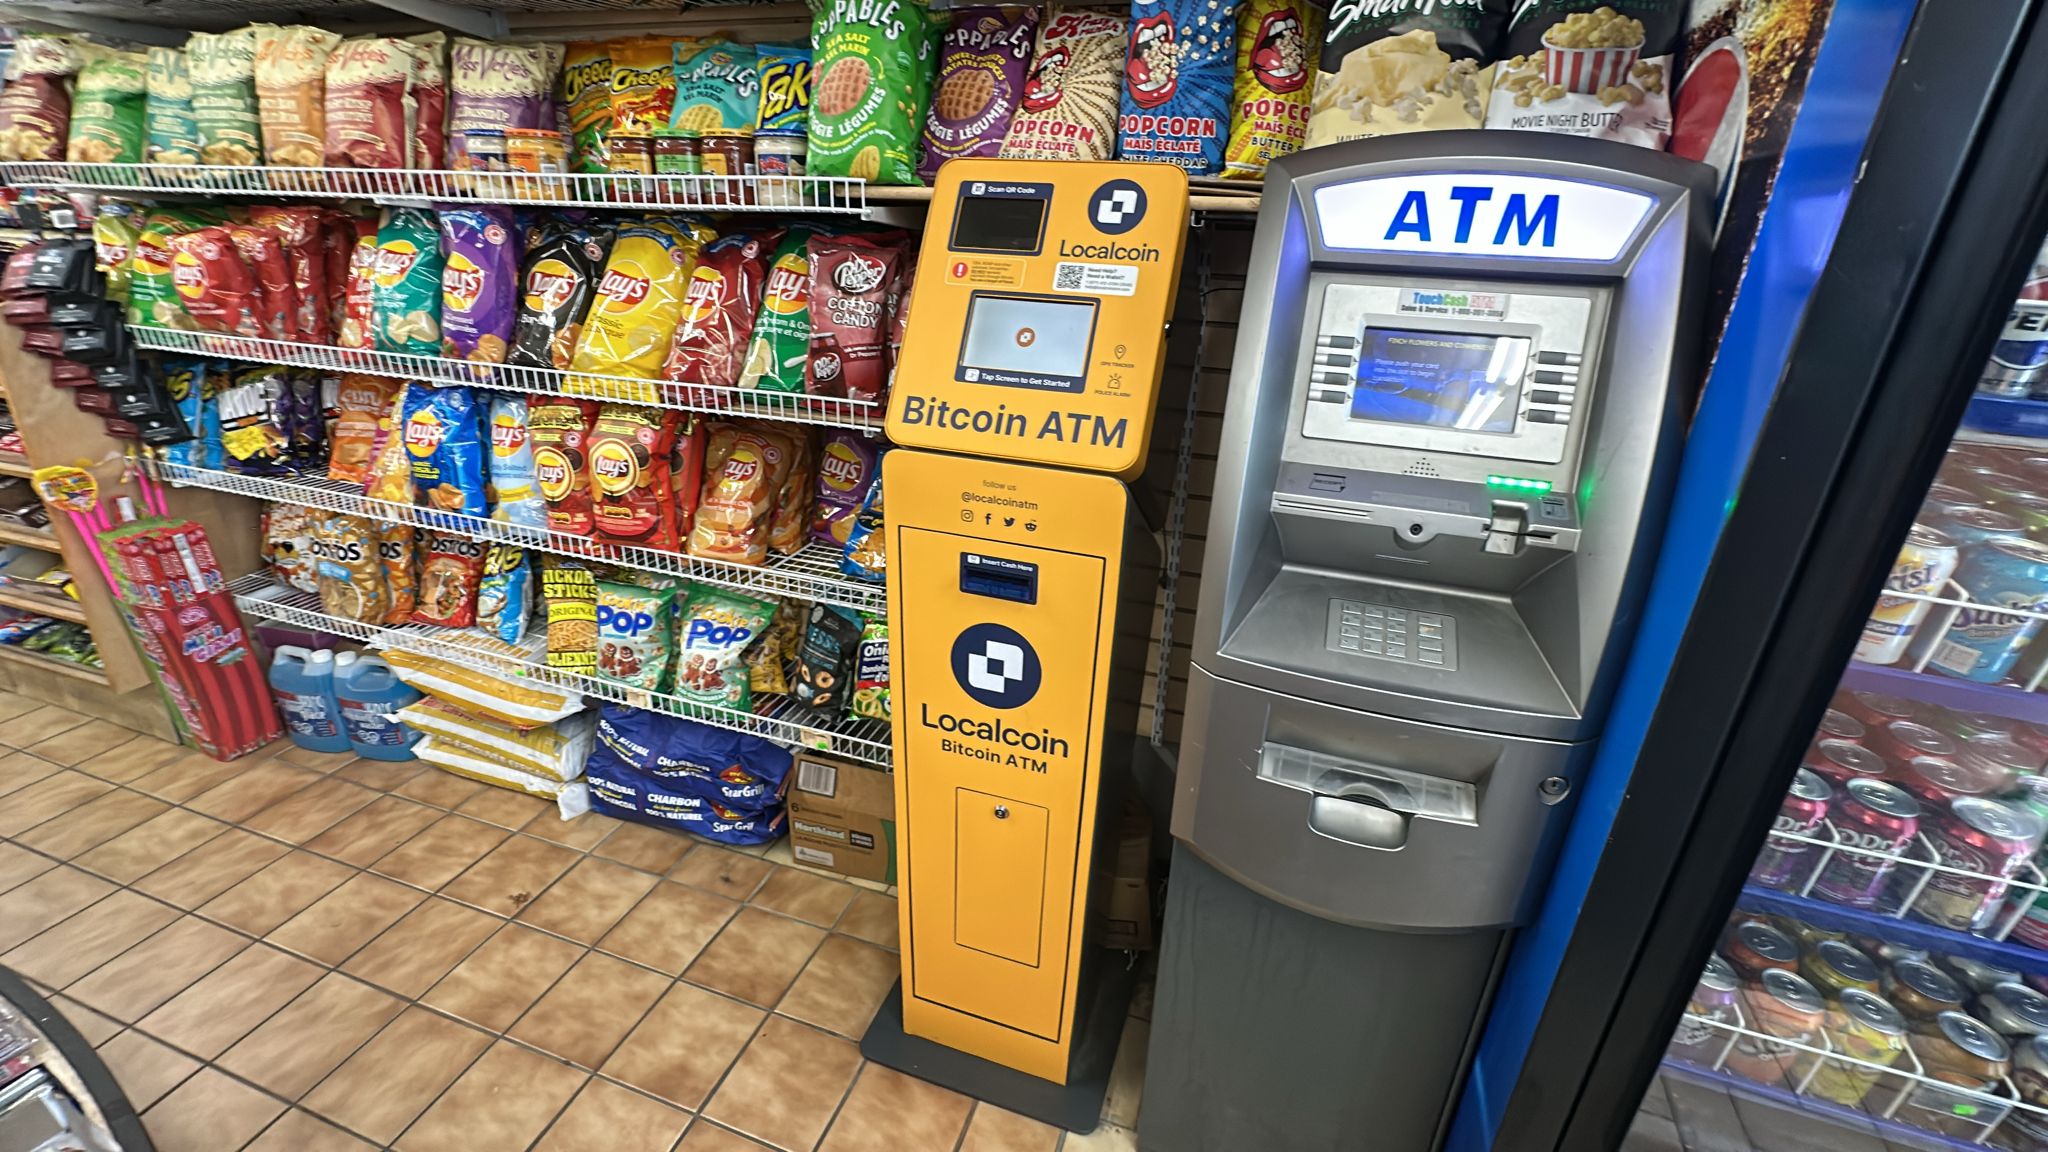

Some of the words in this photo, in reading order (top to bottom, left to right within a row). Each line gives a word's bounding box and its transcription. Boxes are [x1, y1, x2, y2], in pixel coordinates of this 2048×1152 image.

[1242, 100, 1312, 123] POPCO
[1510, 114, 1545, 129] MOVIE
[1545, 114, 1579, 129] NIGHT
[988, 186, 1004, 194] Scan
[1005, 186, 1017, 195] QR
[1017, 186, 1036, 195] Code
[1383, 186, 1561, 248] ATM
[1059, 240, 1160, 262] Localcoin
[831, 311, 882, 330] CANDY
[981, 371, 994, 382] Tap
[995, 373, 1020, 383] Screen
[1028, 377, 1043, 386] Get
[1043, 378, 1070, 388] Started
[902, 396, 1028, 438] Bitcoin
[1036, 410, 1129, 449] ATM
[982, 480, 1006, 491] follow
[1007, 483, 1017, 491] us
[961, 491, 1039, 511] @localcoinatm
[981, 557, 1000, 568] Insert
[1000, 560, 1017, 570] Cash
[1018, 562, 1034, 572] Here
[542, 583, 598, 599] STICKS
[921, 702, 1069, 758] Localcoin
[941, 738, 1002, 764] Bitcoin
[1005, 755, 1048, 775] ATM
[647, 793, 702, 808] CHARBON
[791, 802, 800, 813] 6
